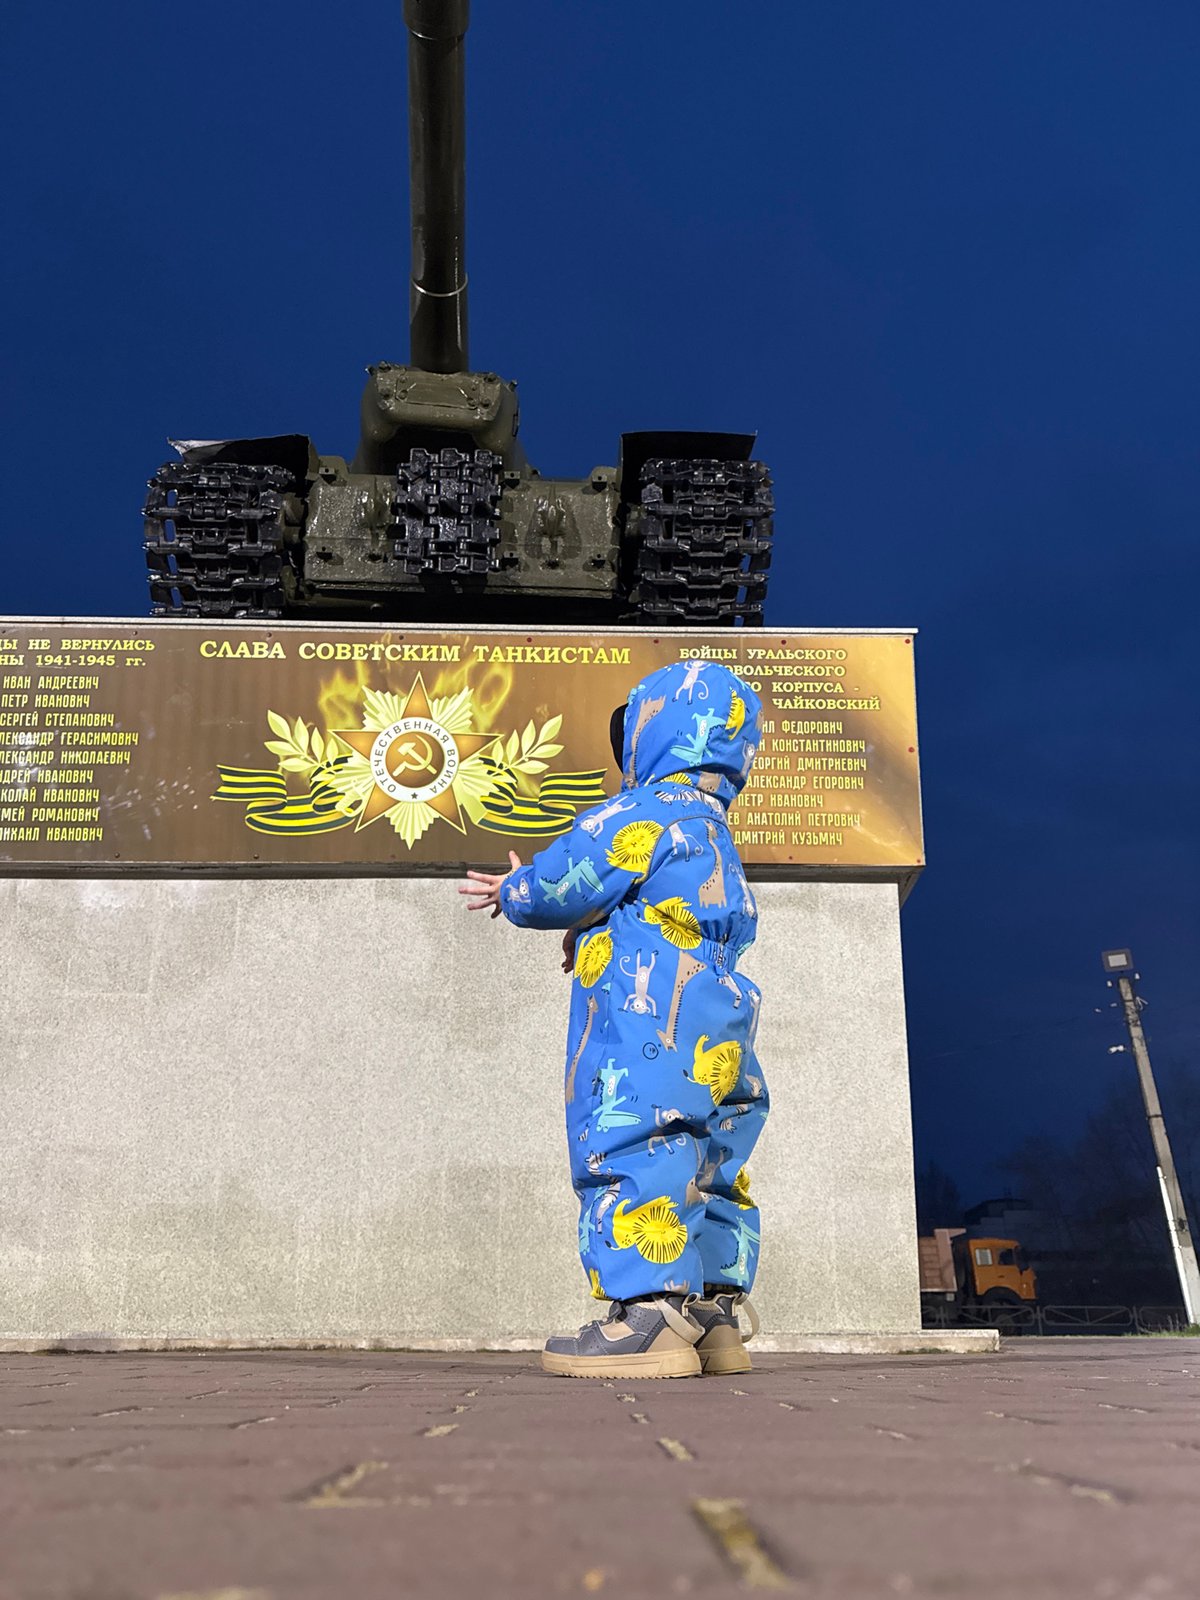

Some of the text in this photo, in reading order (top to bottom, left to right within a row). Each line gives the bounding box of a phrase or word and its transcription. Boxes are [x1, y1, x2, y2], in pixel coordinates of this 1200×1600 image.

[0, 638, 155, 651] Ы НЕ ВЕРНУЛИСЬ
[200, 640, 631, 664] СЛАВА СОВЕТСКИМ ТАНКИСТАМ
[680, 645, 847, 661] БОЙЦЫ УРАЛЬСКОГО
[36, 654, 115, 666] 1941-1945
[125, 658, 146, 667] гг.
[3, 676, 99, 690] ИВАН АНДРЕЕВИЧ
[745, 681, 762, 693] О
[772, 682, 844, 693] КОРПУСА
[1, 694, 90, 708] ПЕТР ИВАНОВИЧ
[772, 696, 880, 710] ЧАЙКОВСКИЙ
[0, 711, 114, 727] СЕРГЕЙ СТЕПАНОВИЧ
[782, 720, 843, 735] ФЕДОРОВИЧ
[61, 732, 139, 746] ГЕРАСИМОВИЧ
[772, 739, 865, 753] КОНСТАНТИНОВИЧ
[61, 751, 131, 765] НИКОЛАЕВИЧ
[374, 721, 450, 793] ОТЕЧЕСТВЕННАЯ
[797, 758, 867, 771] ДМИТРИЕВИЧ
[37, 770, 93, 783] ИВАНОВИЧ
[746, 775, 864, 791] АЛЕКСАНДР ЕГОРОВИЧ
[43, 788, 99, 802] ИВАНОВИЧ
[737, 793, 823, 807] ПЕТР ИВАНОВИЧ
[32, 807, 99, 822] РОМАНОВИЧ
[747, 811, 801, 826] АНАТОЛИЙ
[808, 813, 860, 826] ПЕТРОВИЧ
[46, 827, 103, 842] ИВАНОВИЧ
[734, 829, 843, 845] ДМИТРИЙ КУЗЬМИЧ
